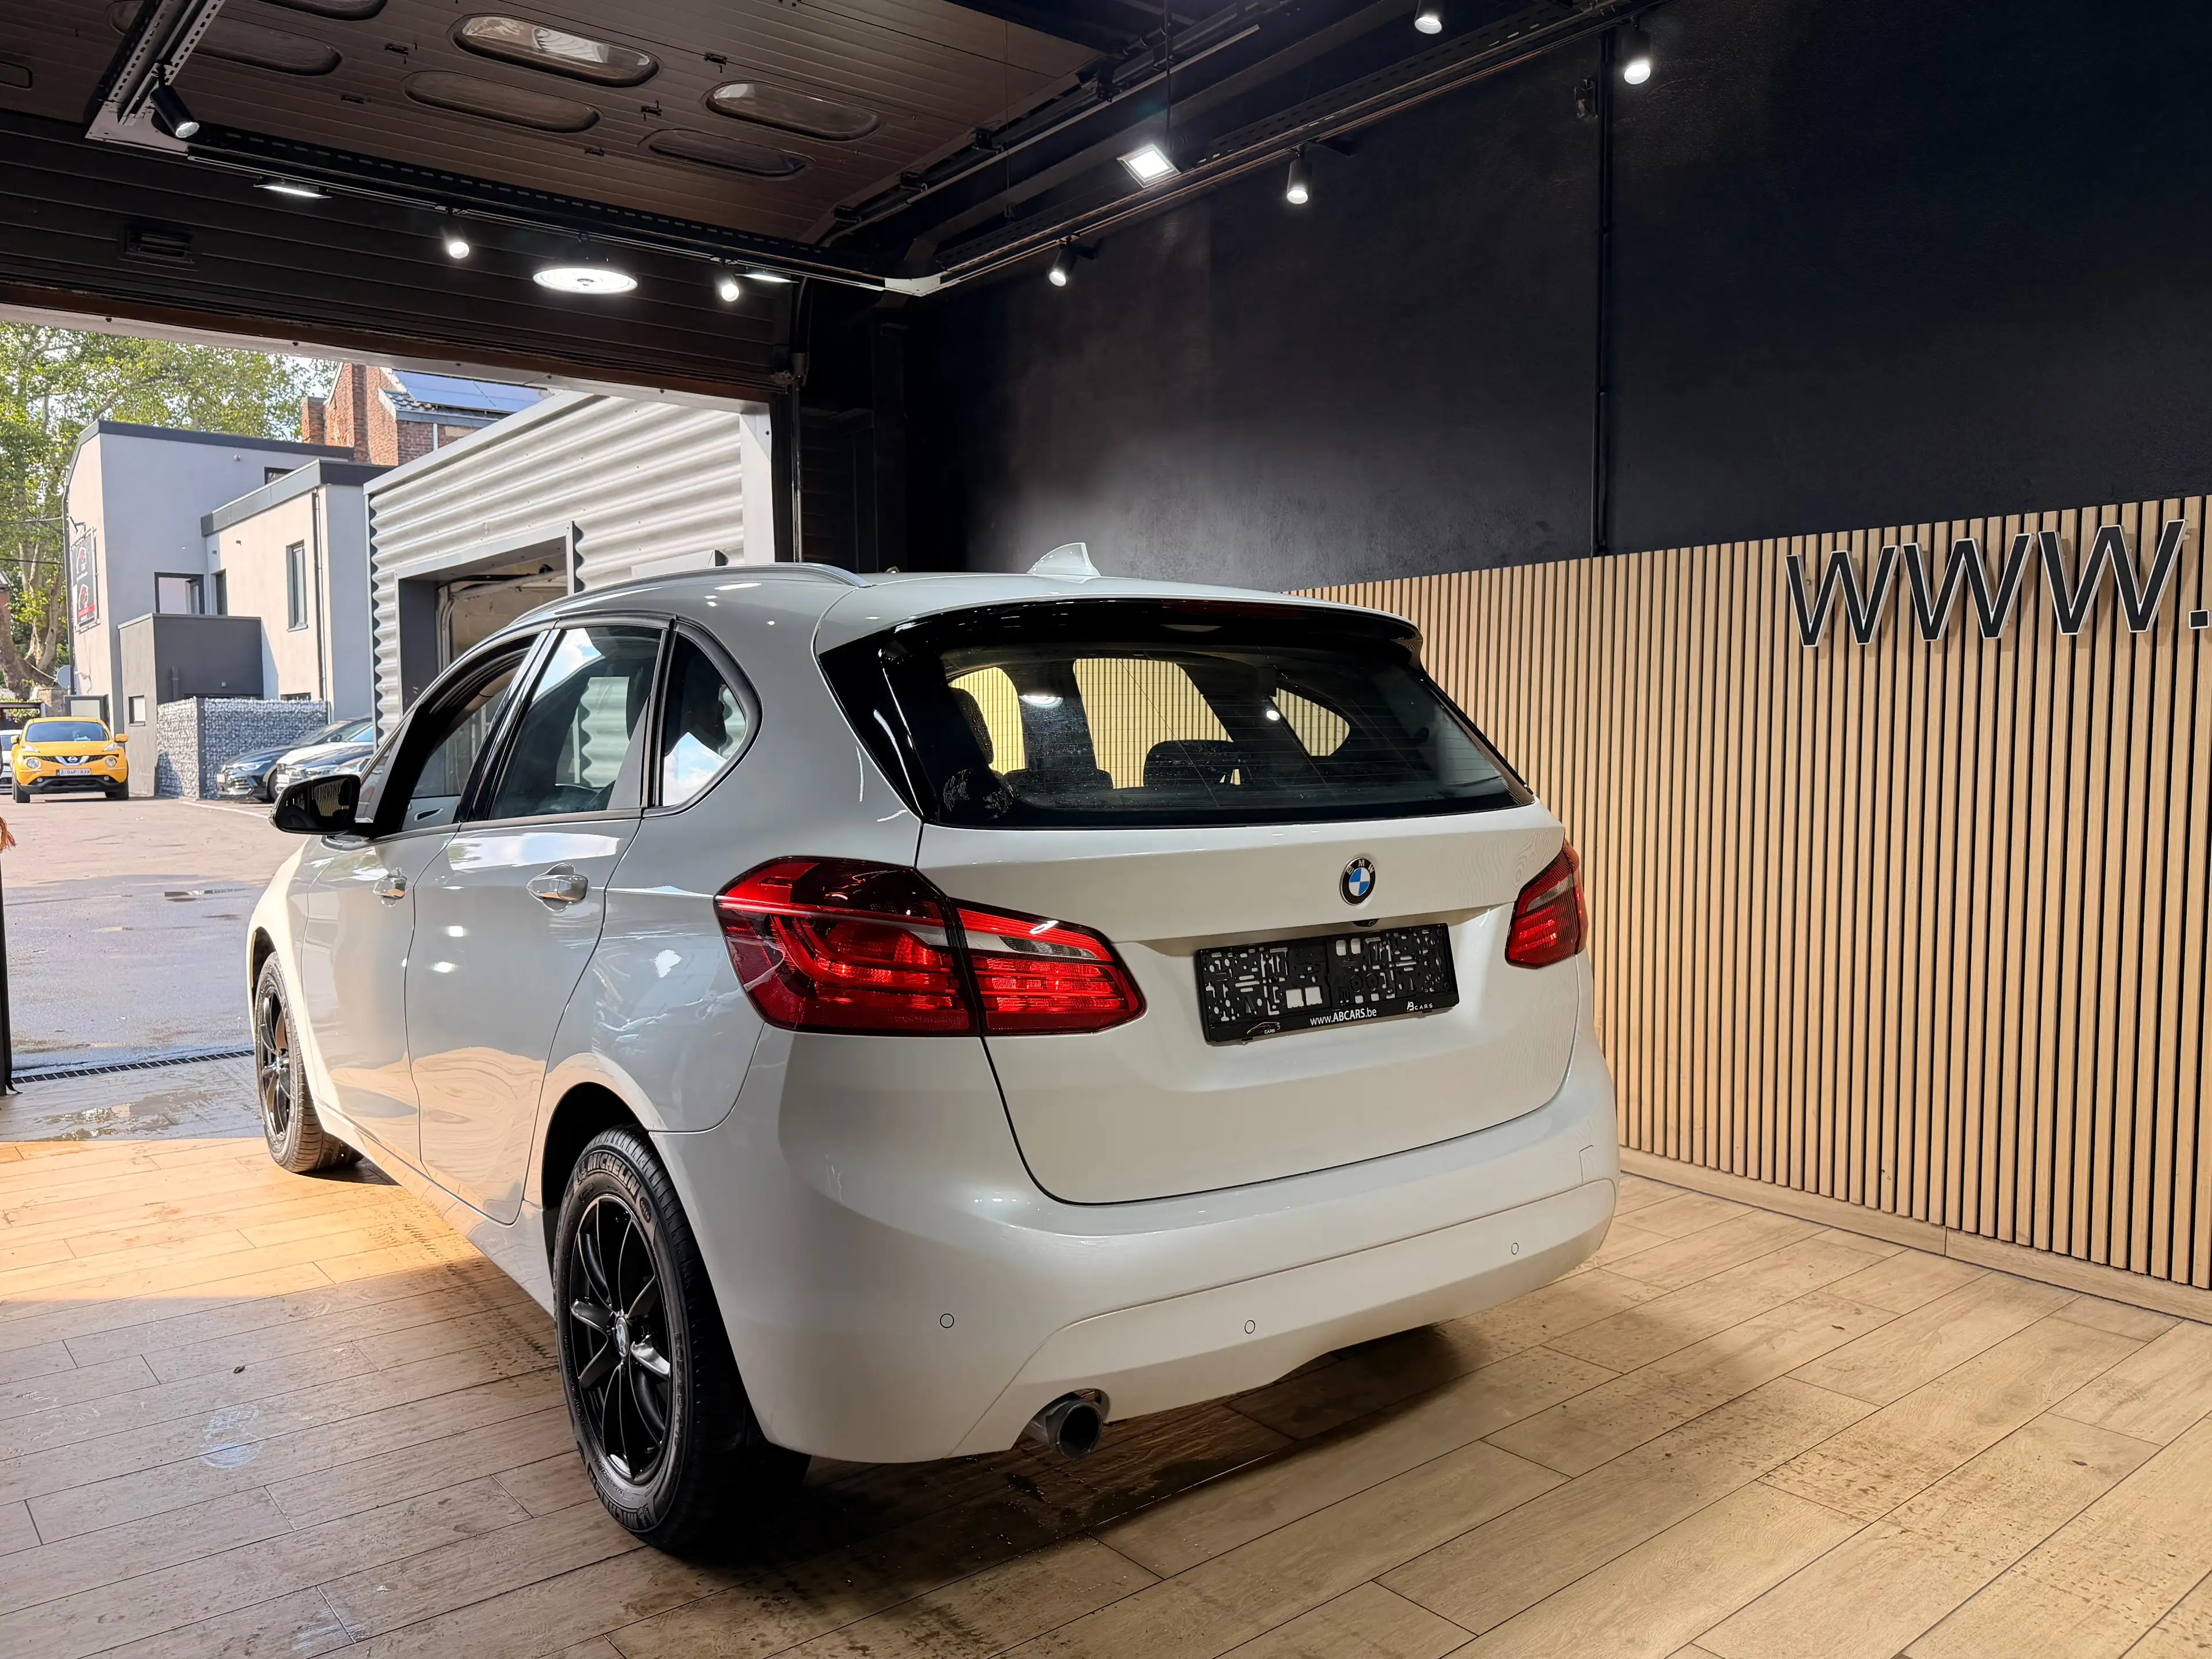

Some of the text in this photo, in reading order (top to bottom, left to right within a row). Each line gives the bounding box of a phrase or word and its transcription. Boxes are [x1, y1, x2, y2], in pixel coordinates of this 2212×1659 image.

[1347, 859, 1374, 875] BMW
[1310, 1007, 1377, 1026] www.ABCARS.be
[588, 1153, 641, 1196] MICHELIN
